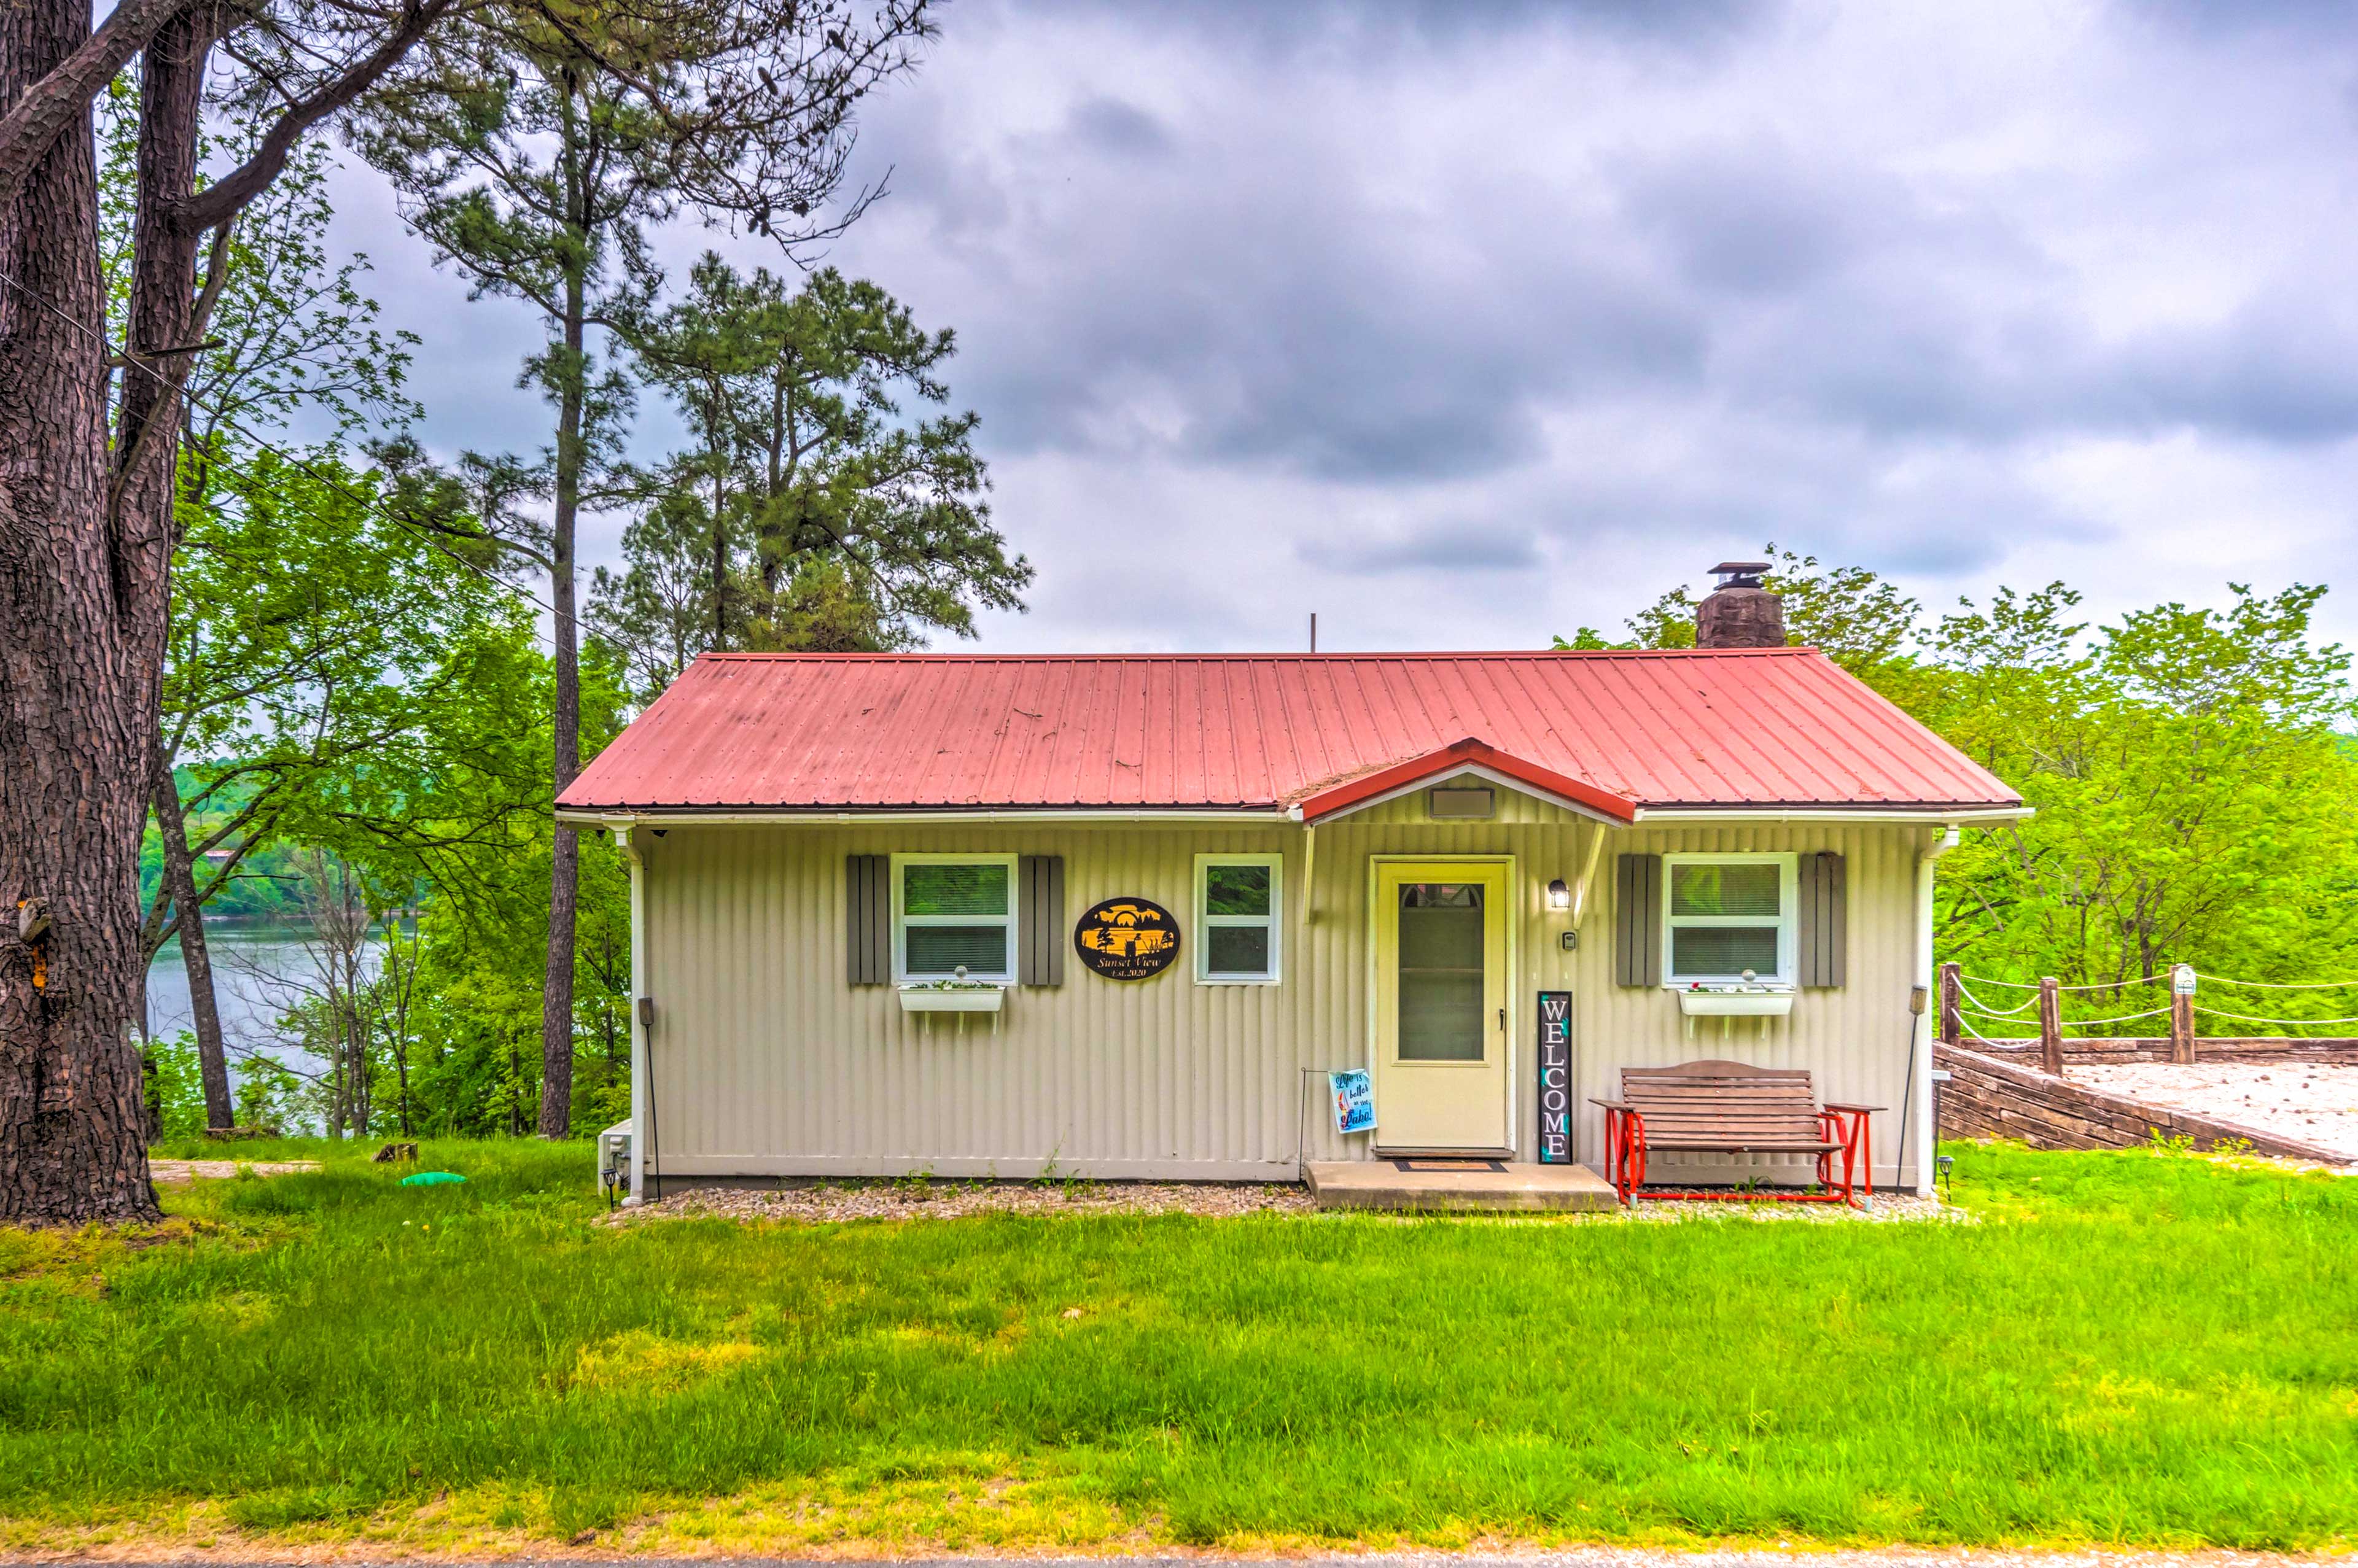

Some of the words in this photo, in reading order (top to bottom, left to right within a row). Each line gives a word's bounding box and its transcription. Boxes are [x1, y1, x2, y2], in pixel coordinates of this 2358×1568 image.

[1097, 958, 1130, 968] Sunset
[1135, 956, 1161, 967] View
[1336, 1074, 1353, 1089] Life
[1543, 1001, 1568, 1156] WELCOME
[1350, 1084, 1368, 1099] better
[1341, 1103, 1372, 1128] Lake!
